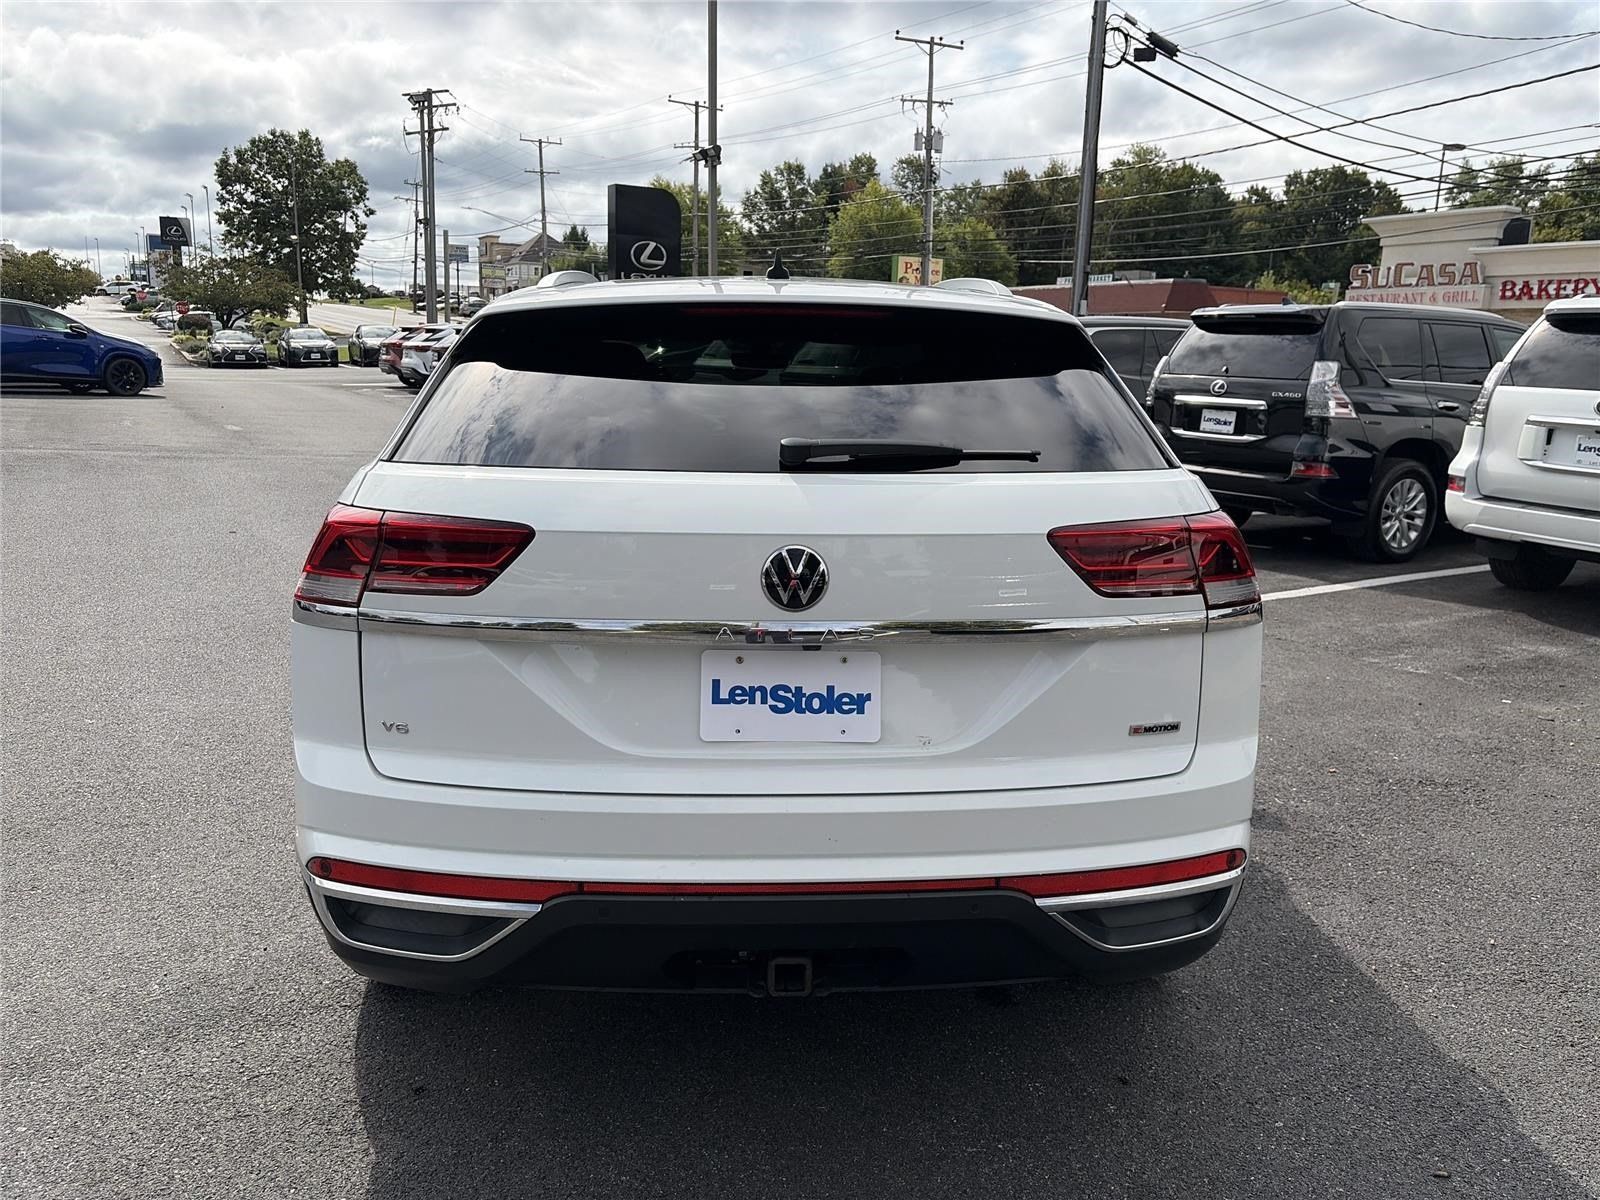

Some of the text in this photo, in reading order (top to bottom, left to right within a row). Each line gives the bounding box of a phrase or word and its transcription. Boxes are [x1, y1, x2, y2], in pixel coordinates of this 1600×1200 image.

[1429, 293, 1438, 304] &
[1442, 290, 1479, 304] GRILL
[715, 626, 876, 642] ATLAS
[381, 720, 409, 735] V6
